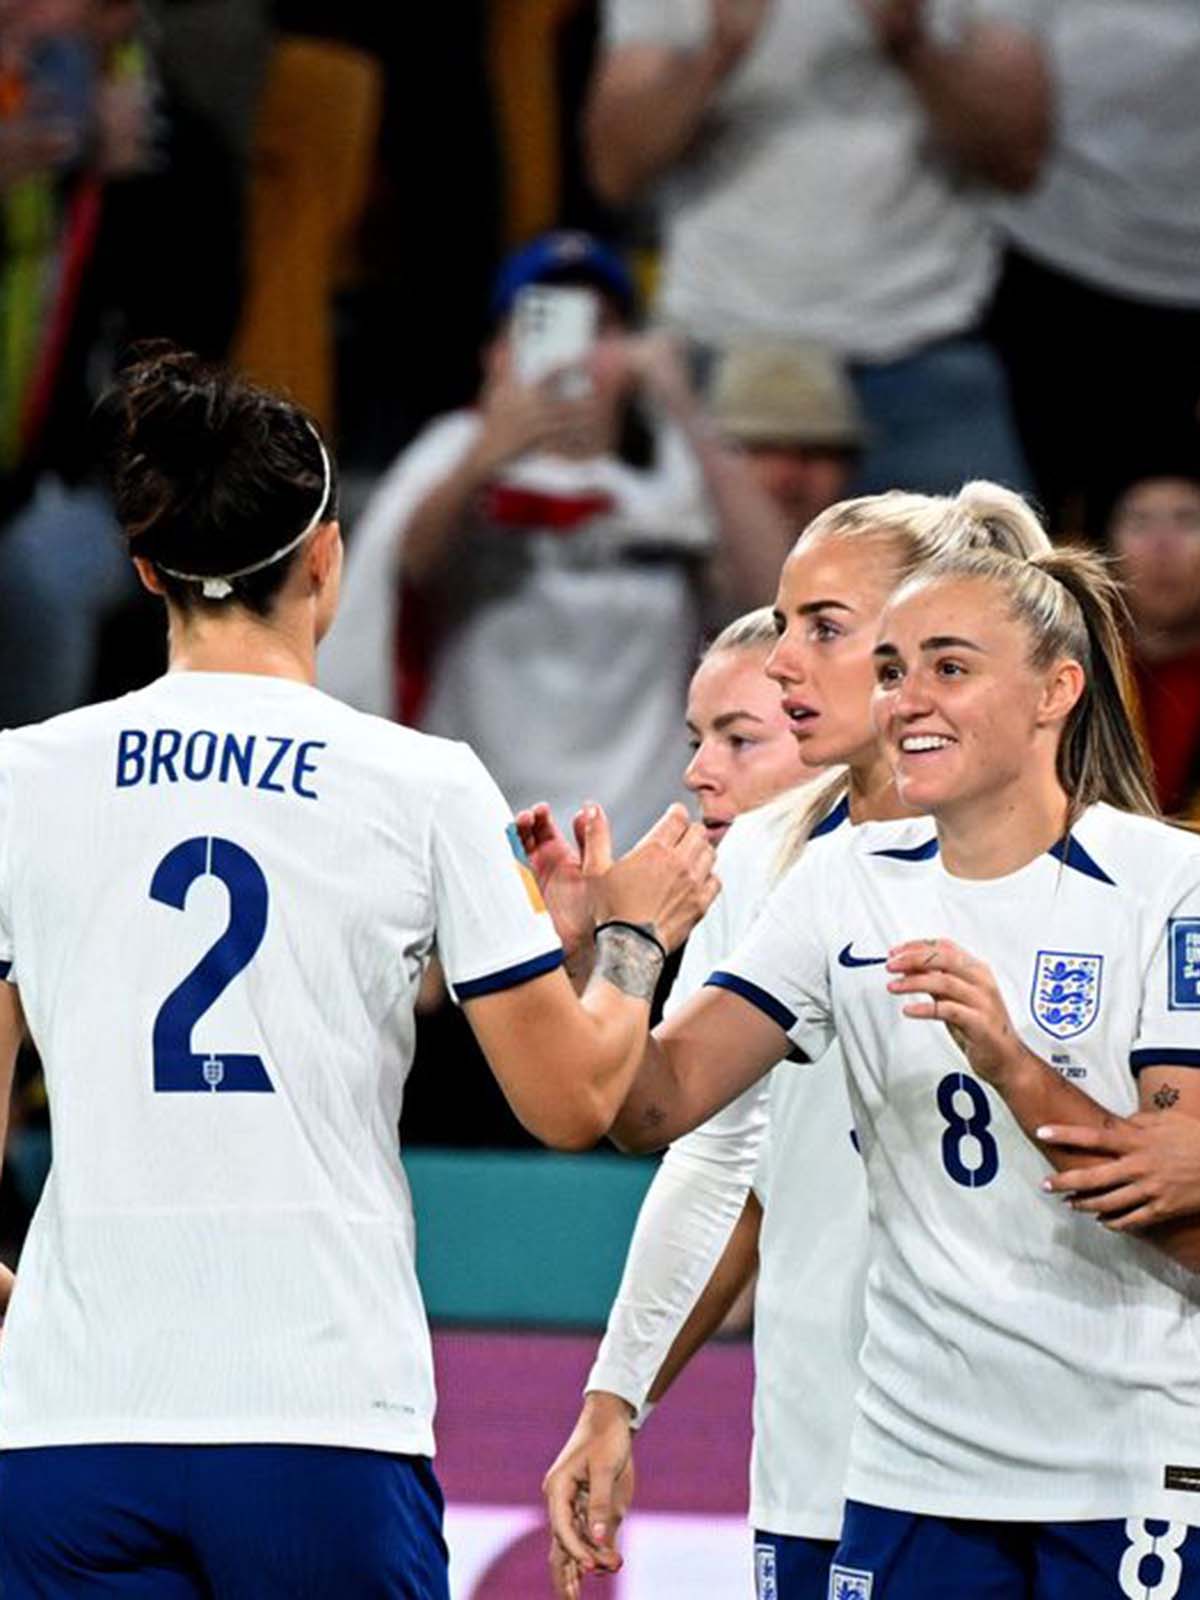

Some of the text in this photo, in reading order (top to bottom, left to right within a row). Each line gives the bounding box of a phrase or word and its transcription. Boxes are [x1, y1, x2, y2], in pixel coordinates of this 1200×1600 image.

[116, 729, 326, 800] BRONZE
[148, 836, 276, 1092] 2
[937, 1071, 999, 1188] 8
[1118, 1517, 1187, 1600] 8
